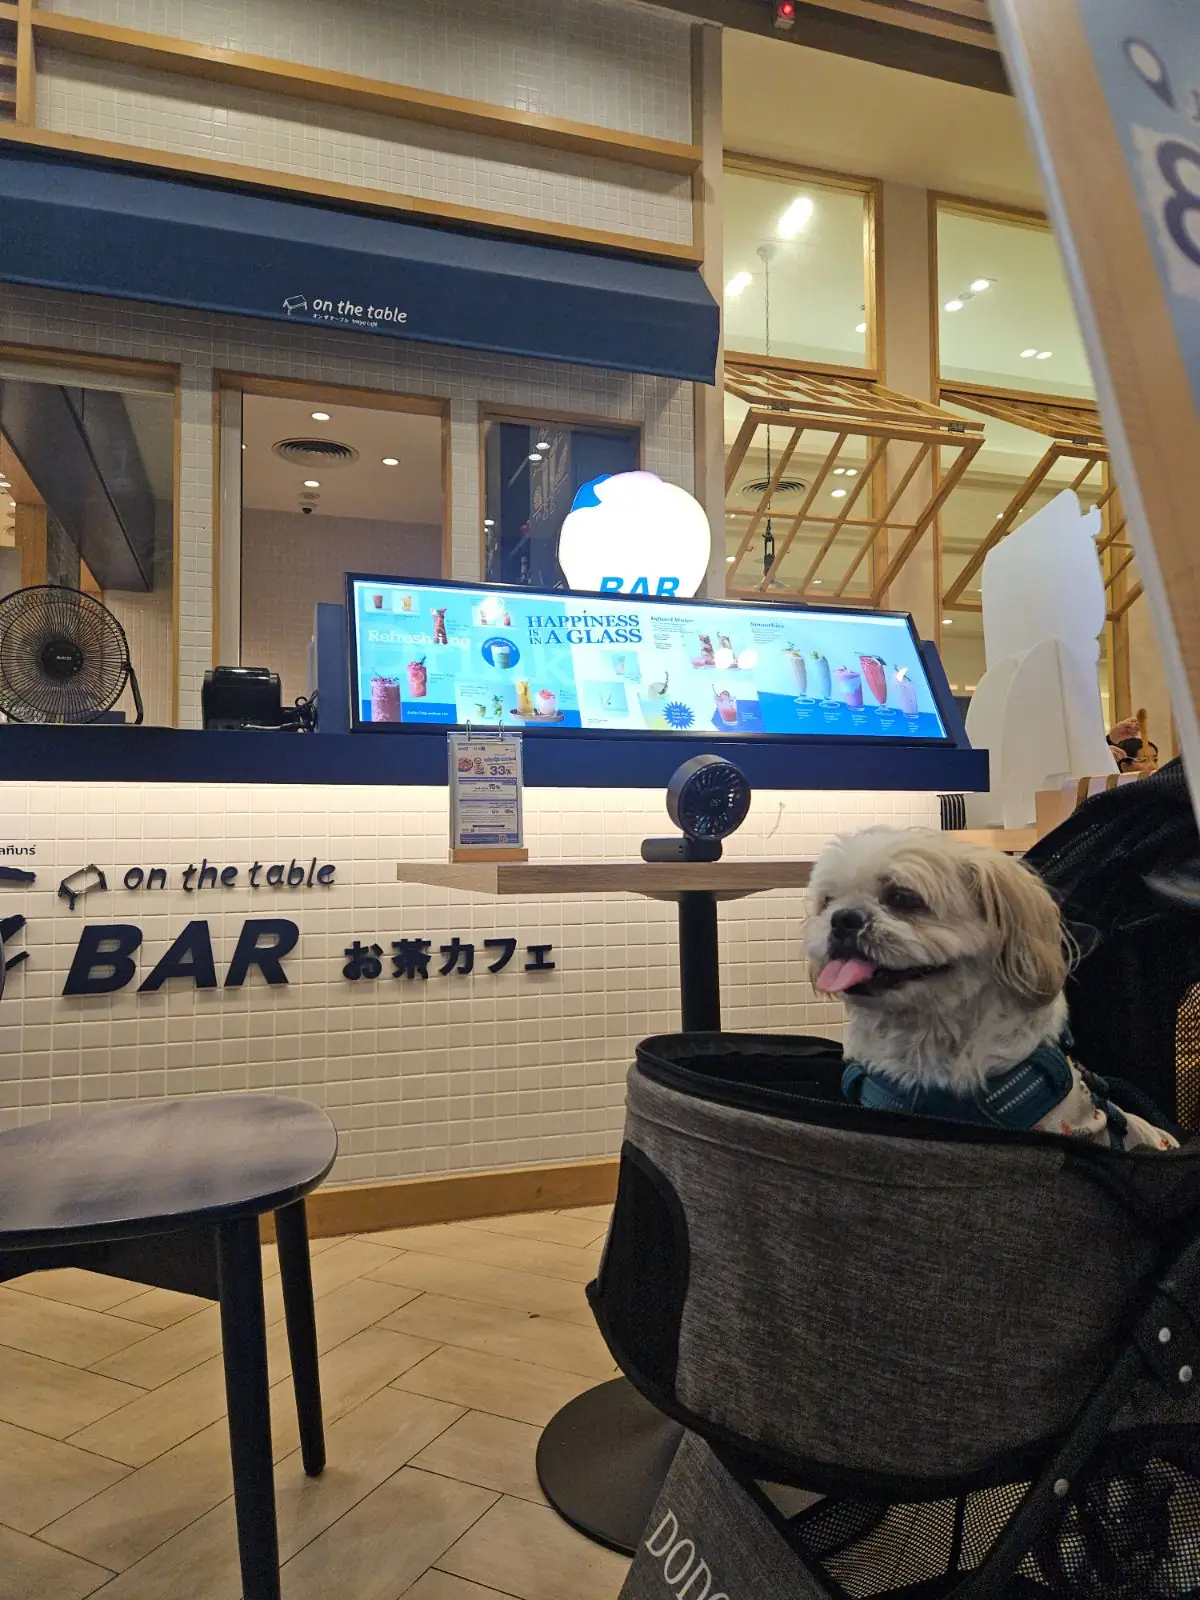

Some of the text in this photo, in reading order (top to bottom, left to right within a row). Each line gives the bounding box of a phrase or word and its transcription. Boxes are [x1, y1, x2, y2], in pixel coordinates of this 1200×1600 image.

[312, 299, 408, 323] on the table
[600, 576, 680, 597] BAR
[526, 614, 640, 628] HAPPINESS
[529, 637, 542, 645] IN
[545, 629, 563, 645] A
[566, 628, 643, 645] GLASS
[123, 857, 336, 892] on the table
[62, 918, 300, 996] BAR
[342, 937, 556, 981] お茶カフェ
